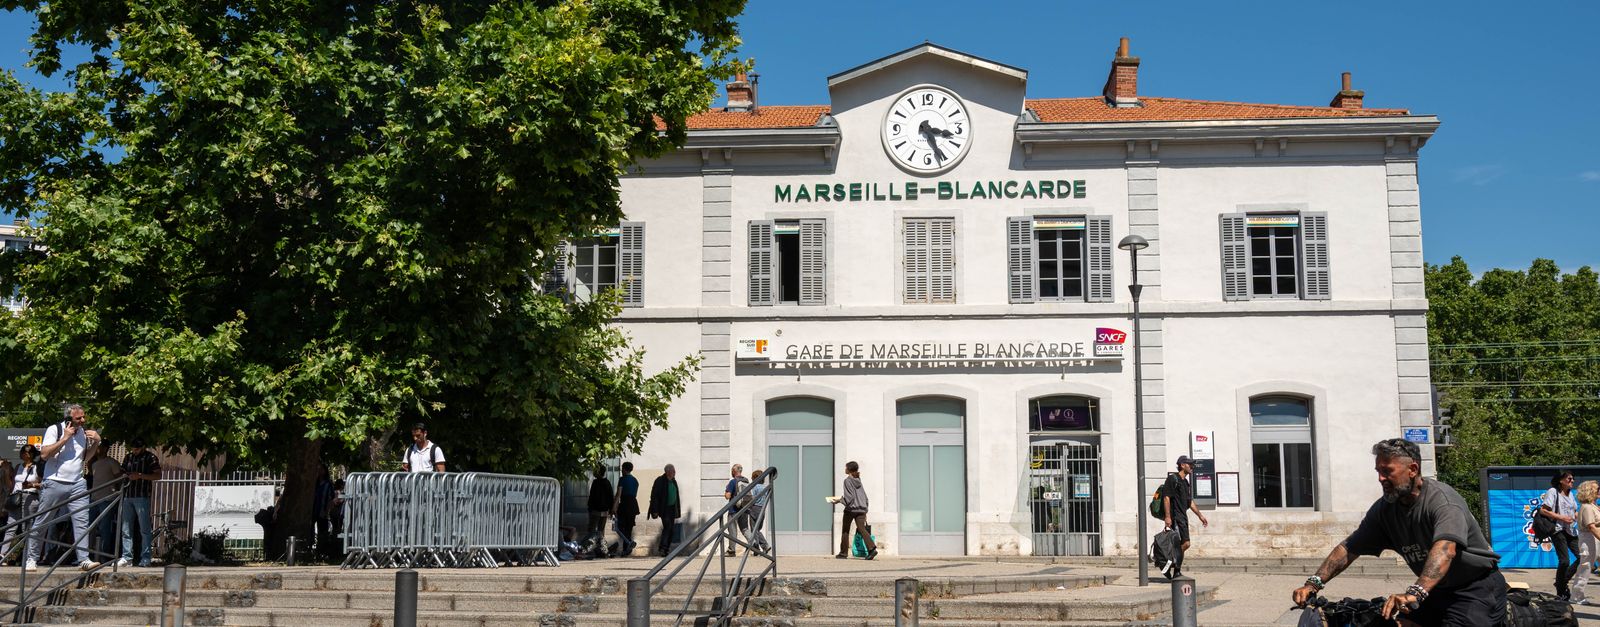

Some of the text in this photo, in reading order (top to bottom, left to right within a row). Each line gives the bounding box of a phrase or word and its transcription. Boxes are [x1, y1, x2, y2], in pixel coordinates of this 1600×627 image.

[922, 93, 934, 106] 12
[892, 123, 902, 136] 9
[954, 122, 963, 135] 3
[923, 153, 932, 166] 6
[775, 180, 1087, 202] MARSEILLE-BLANCARDE
[1098, 333, 1124, 341] SNCF
[786, 342, 1085, 359] GARE DE MARSEILLE BLANCARDE
